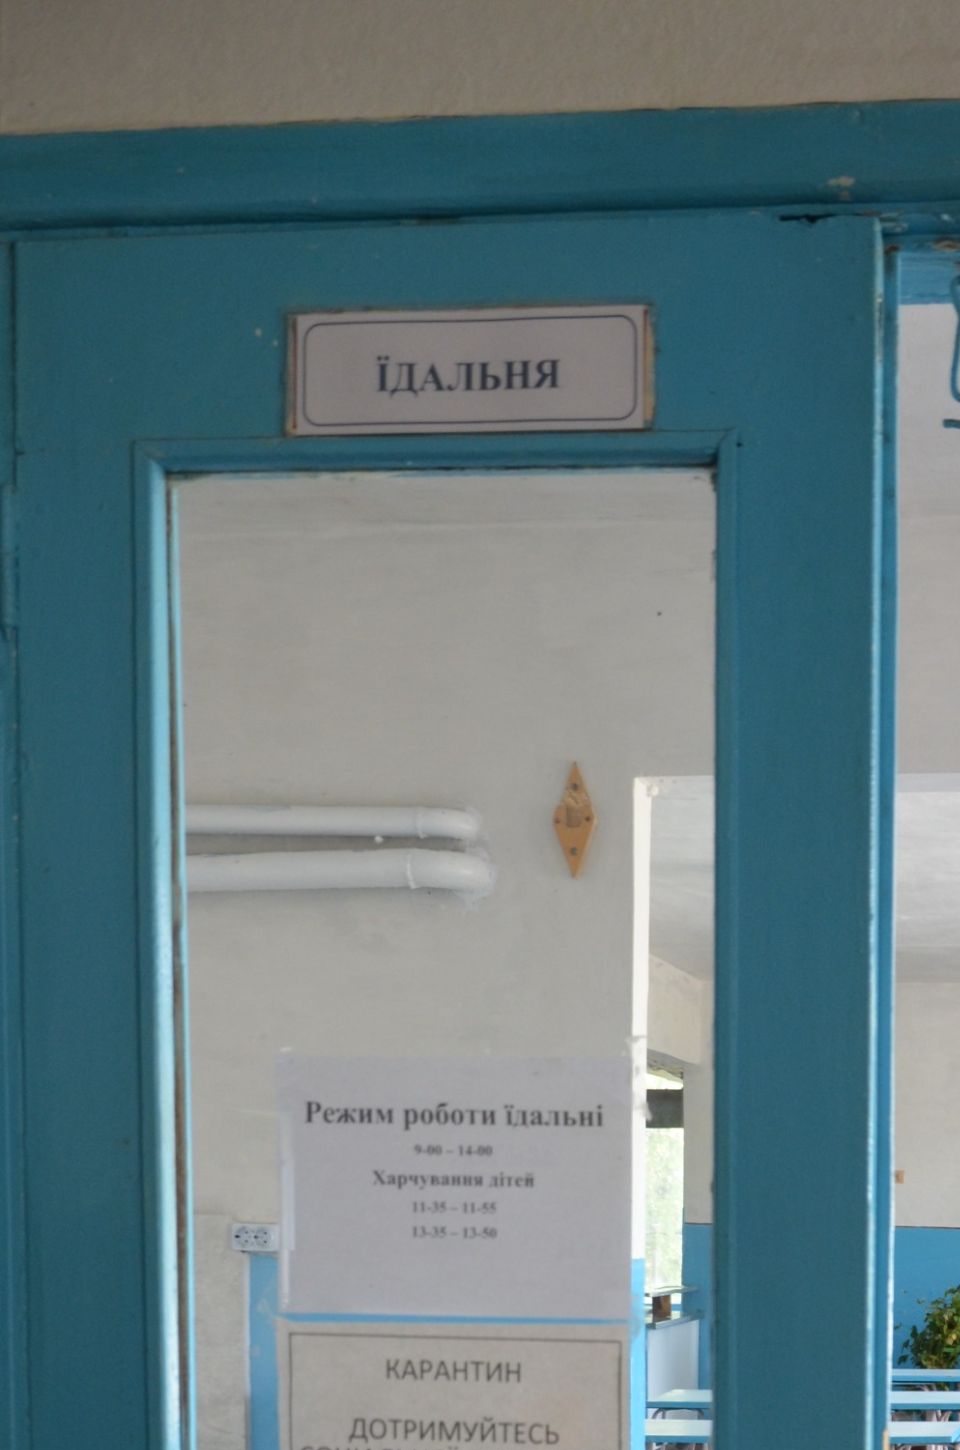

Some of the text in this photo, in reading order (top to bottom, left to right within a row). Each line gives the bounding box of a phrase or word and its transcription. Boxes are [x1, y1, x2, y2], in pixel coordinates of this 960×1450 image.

[376, 355, 560, 397] ЇДАЛЬНЯ
[304, 1100, 604, 1130] Режим роботи їдальні
[373, 1169, 535, 1190] Харчування дітей
[385, 1359, 522, 1383] КАРАНТИН
[348, 1416, 560, 1445] ДОТРИМУЙТЕСЬ
